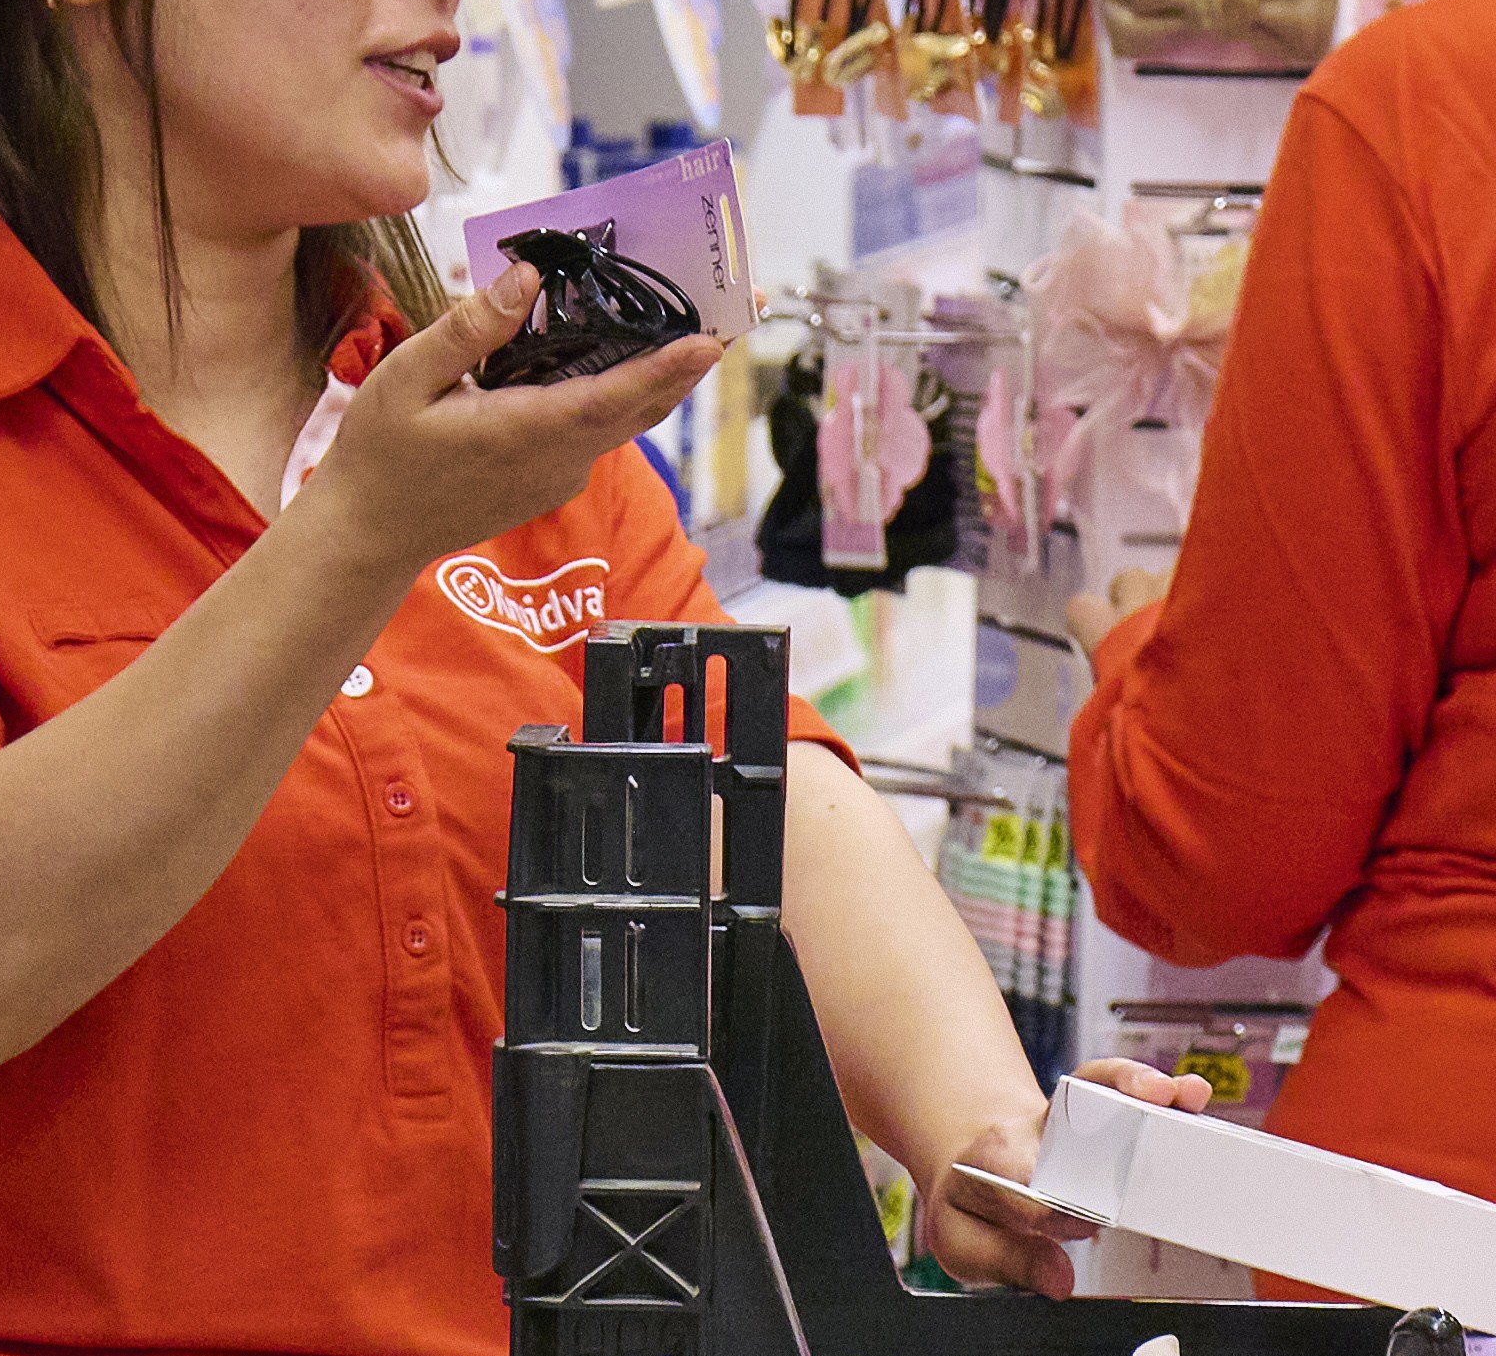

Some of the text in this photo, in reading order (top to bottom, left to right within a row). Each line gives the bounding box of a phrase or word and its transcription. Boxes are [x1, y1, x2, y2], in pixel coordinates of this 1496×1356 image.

[678, 148, 720, 184] hair
[701, 193, 726, 293] zenner
[489, 576, 604, 635] Kruidva
